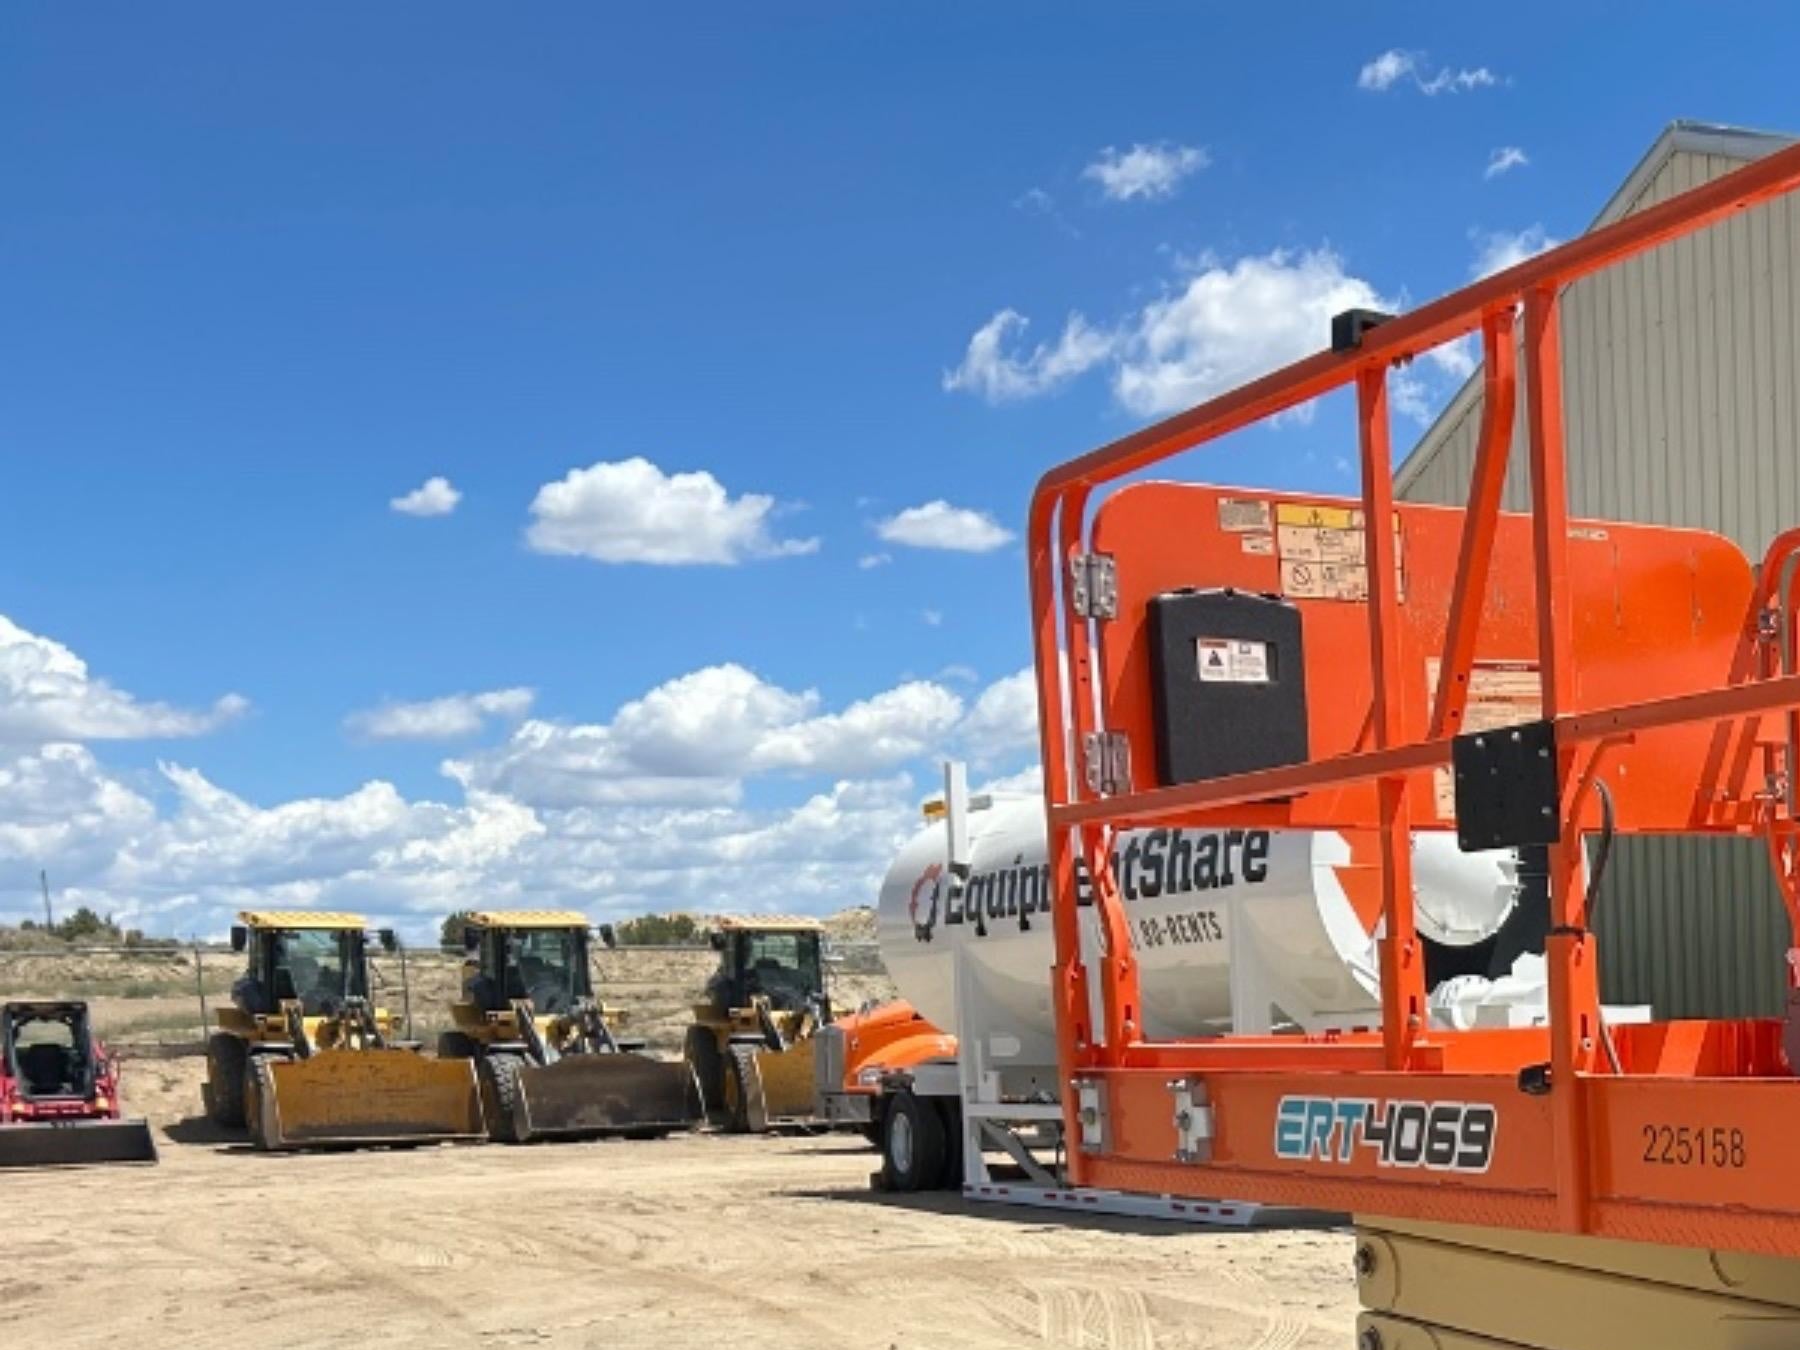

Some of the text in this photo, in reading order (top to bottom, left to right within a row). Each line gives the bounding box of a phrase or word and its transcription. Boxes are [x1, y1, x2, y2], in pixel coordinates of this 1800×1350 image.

[944, 827, 1270, 936] EquipetShare
[1275, 1095, 1496, 1173] ERT4069
[1642, 1124, 1746, 1168] 225158
